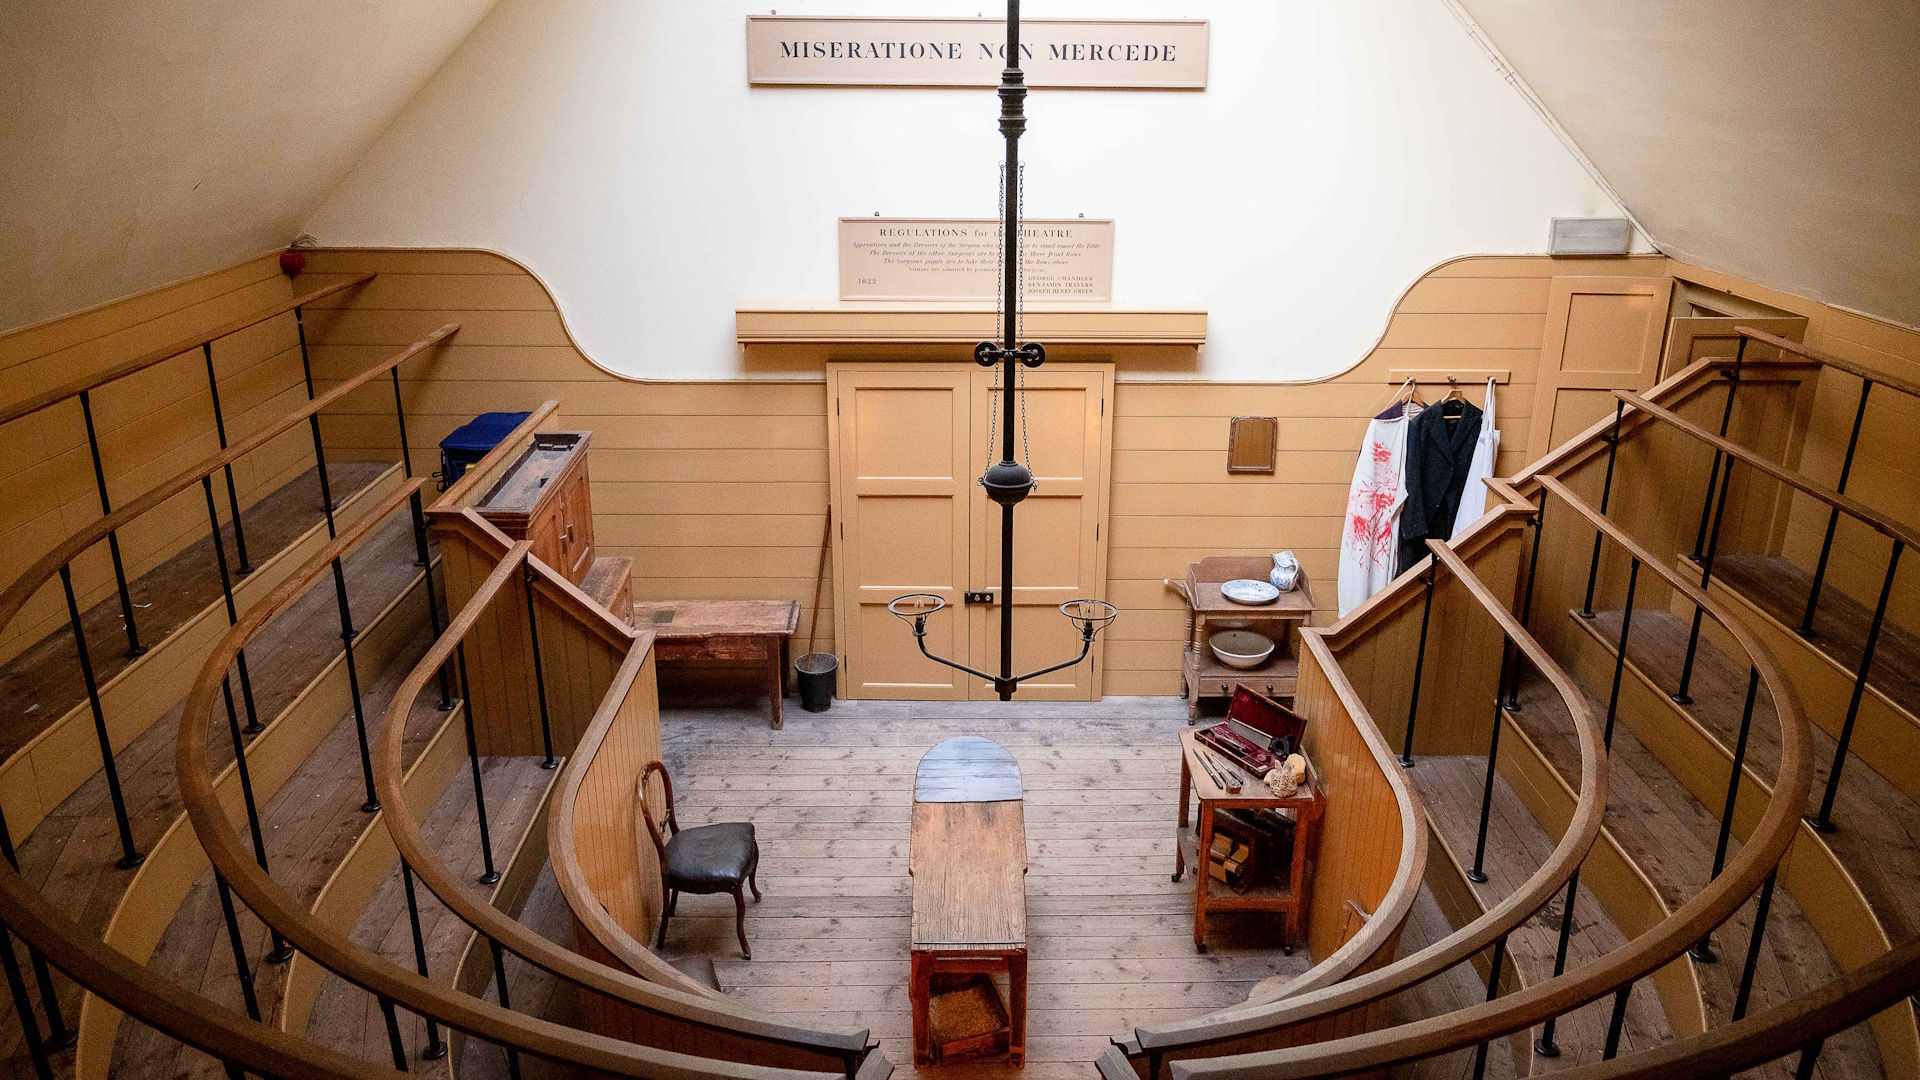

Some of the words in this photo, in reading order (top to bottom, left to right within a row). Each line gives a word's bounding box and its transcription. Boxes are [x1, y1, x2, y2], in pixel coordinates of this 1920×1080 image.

[780, 41, 962, 60] MISERATIONE
[978, 43, 1034, 60] NON
[1048, 43, 1176, 62] MERCEDE
[880, 228, 968, 237] REGULATIONS
[974, 229, 989, 237] for
